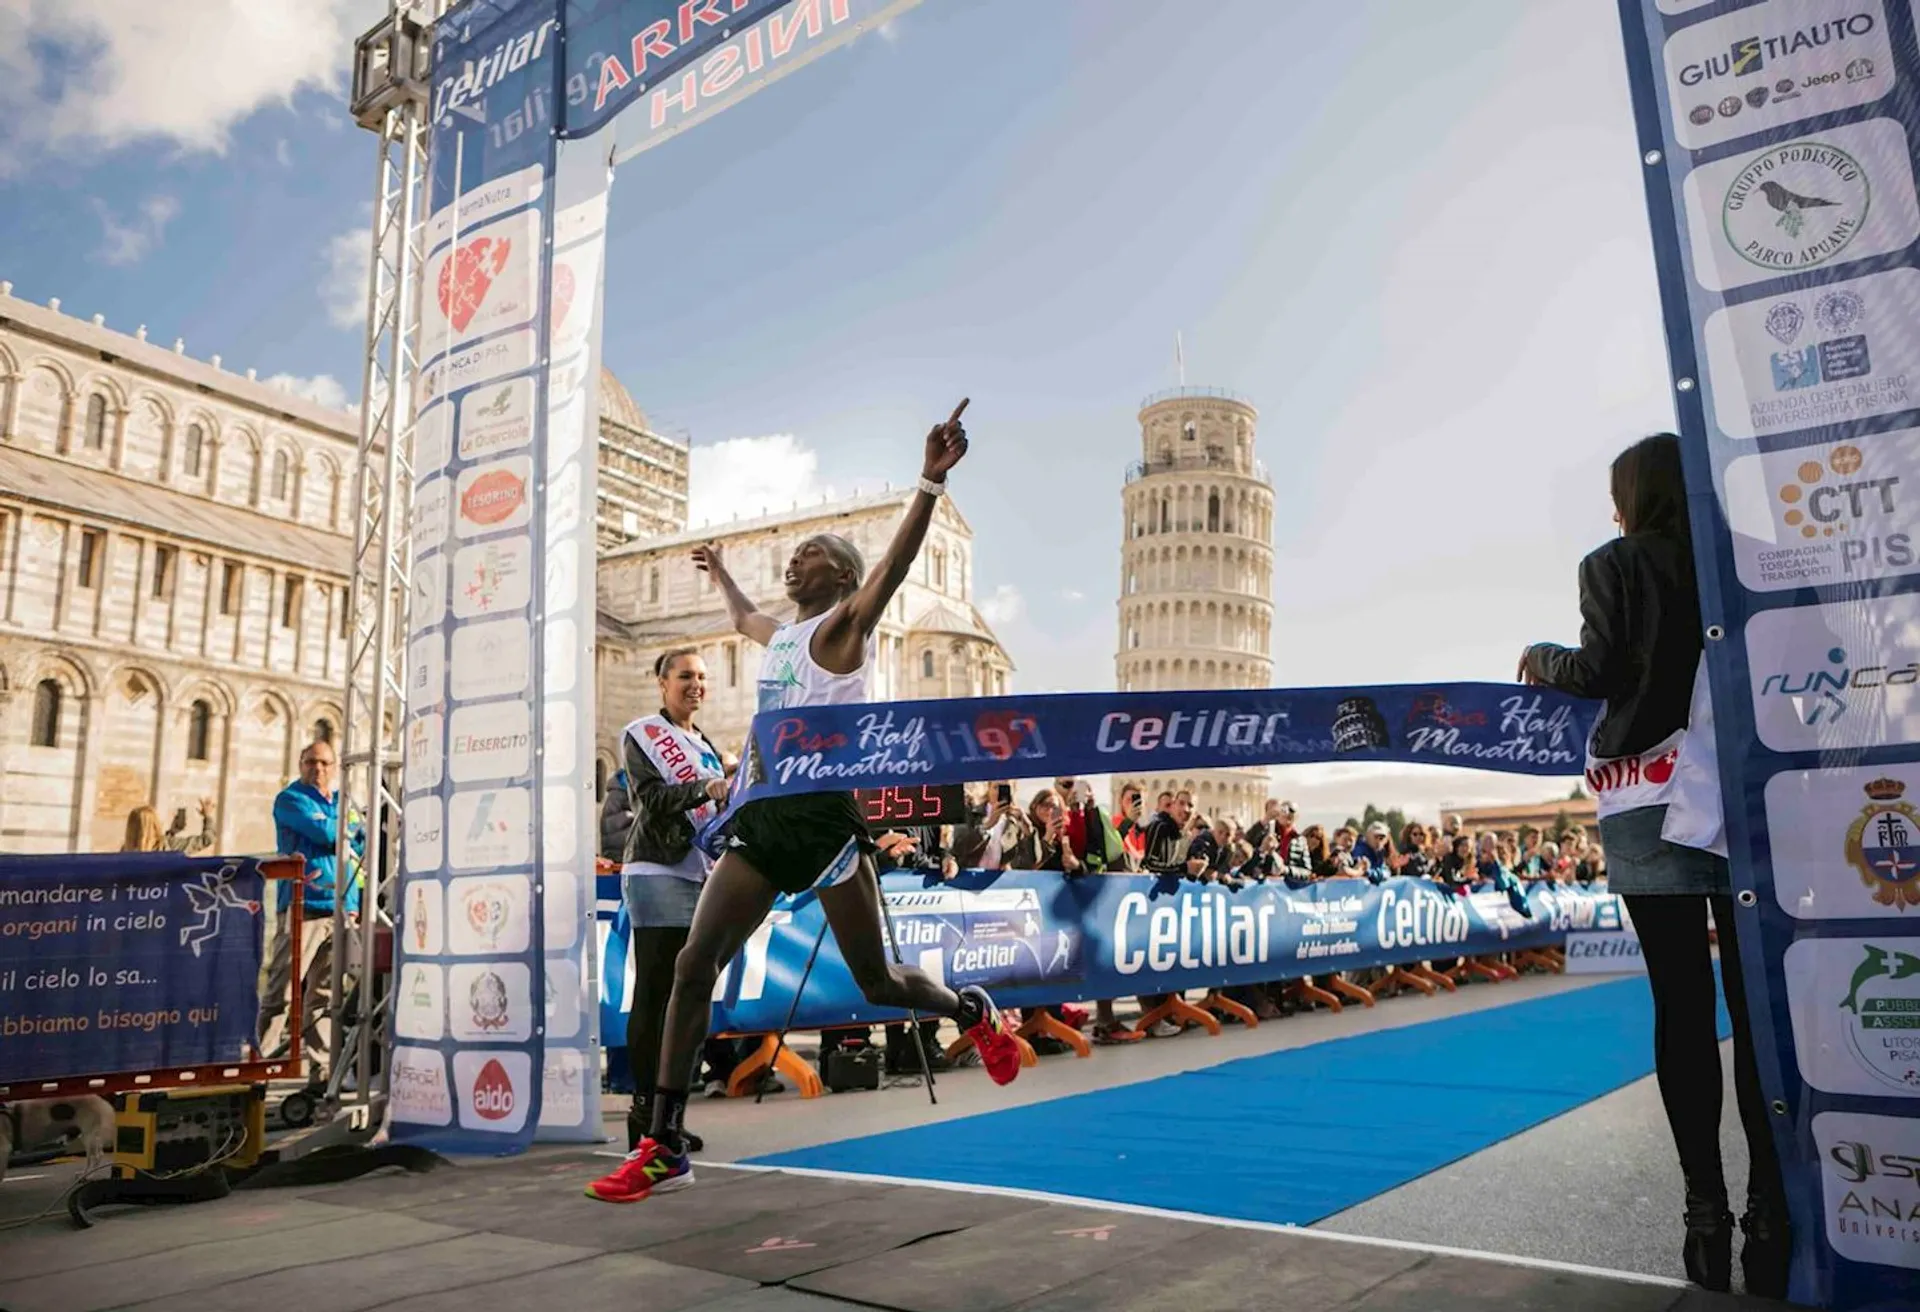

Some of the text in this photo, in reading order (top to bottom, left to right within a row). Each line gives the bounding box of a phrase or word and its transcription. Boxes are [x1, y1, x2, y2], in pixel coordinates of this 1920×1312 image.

[593, 0, 748, 112] ARR
[1679, 13, 1874, 86] GIUSTIAUTO
[434, 19, 556, 124] Cetilar
[1800, 71, 1841, 88] Jeep
[1728, 148, 1858, 211] GRUPPO PODISTICO
[1744, 217, 1857, 265] PARCO APUANE
[1750, 374, 1908, 415] AZIENDA OSPEDALIERO
[1752, 390, 1910, 429] UNIVERSITARIA PISANA
[1808, 476, 1900, 522] CTT
[1757, 544, 1834, 562] COMPAGNIA
[1759, 556, 1820, 573] TOSCANA
[1760, 566, 1833, 584] TRASPORTI
[772, 710, 928, 759] Pisa Half
[1096, 709, 1290, 753] Cetilar
[1407, 691, 1573, 745] Pisa Half
[655, 735, 686, 768] PER
[1407, 726, 1578, 765] Marathon
[775, 748, 935, 785] Marathon
[1586, 756, 1641, 793] VITA
[0, 882, 170, 905] mandare i tuoi
[3, 909, 167, 940] organi in cielo
[1114, 892, 1275, 974] Cetilar
[1378, 889, 1470, 949] Cetilar
[953, 943, 1018, 973] Cetilar
[2, 966, 158, 991] il cielo lo sa...
[0, 1003, 220, 1036] bbiamo bisogno qui
[474, 1089, 513, 1111] aido
